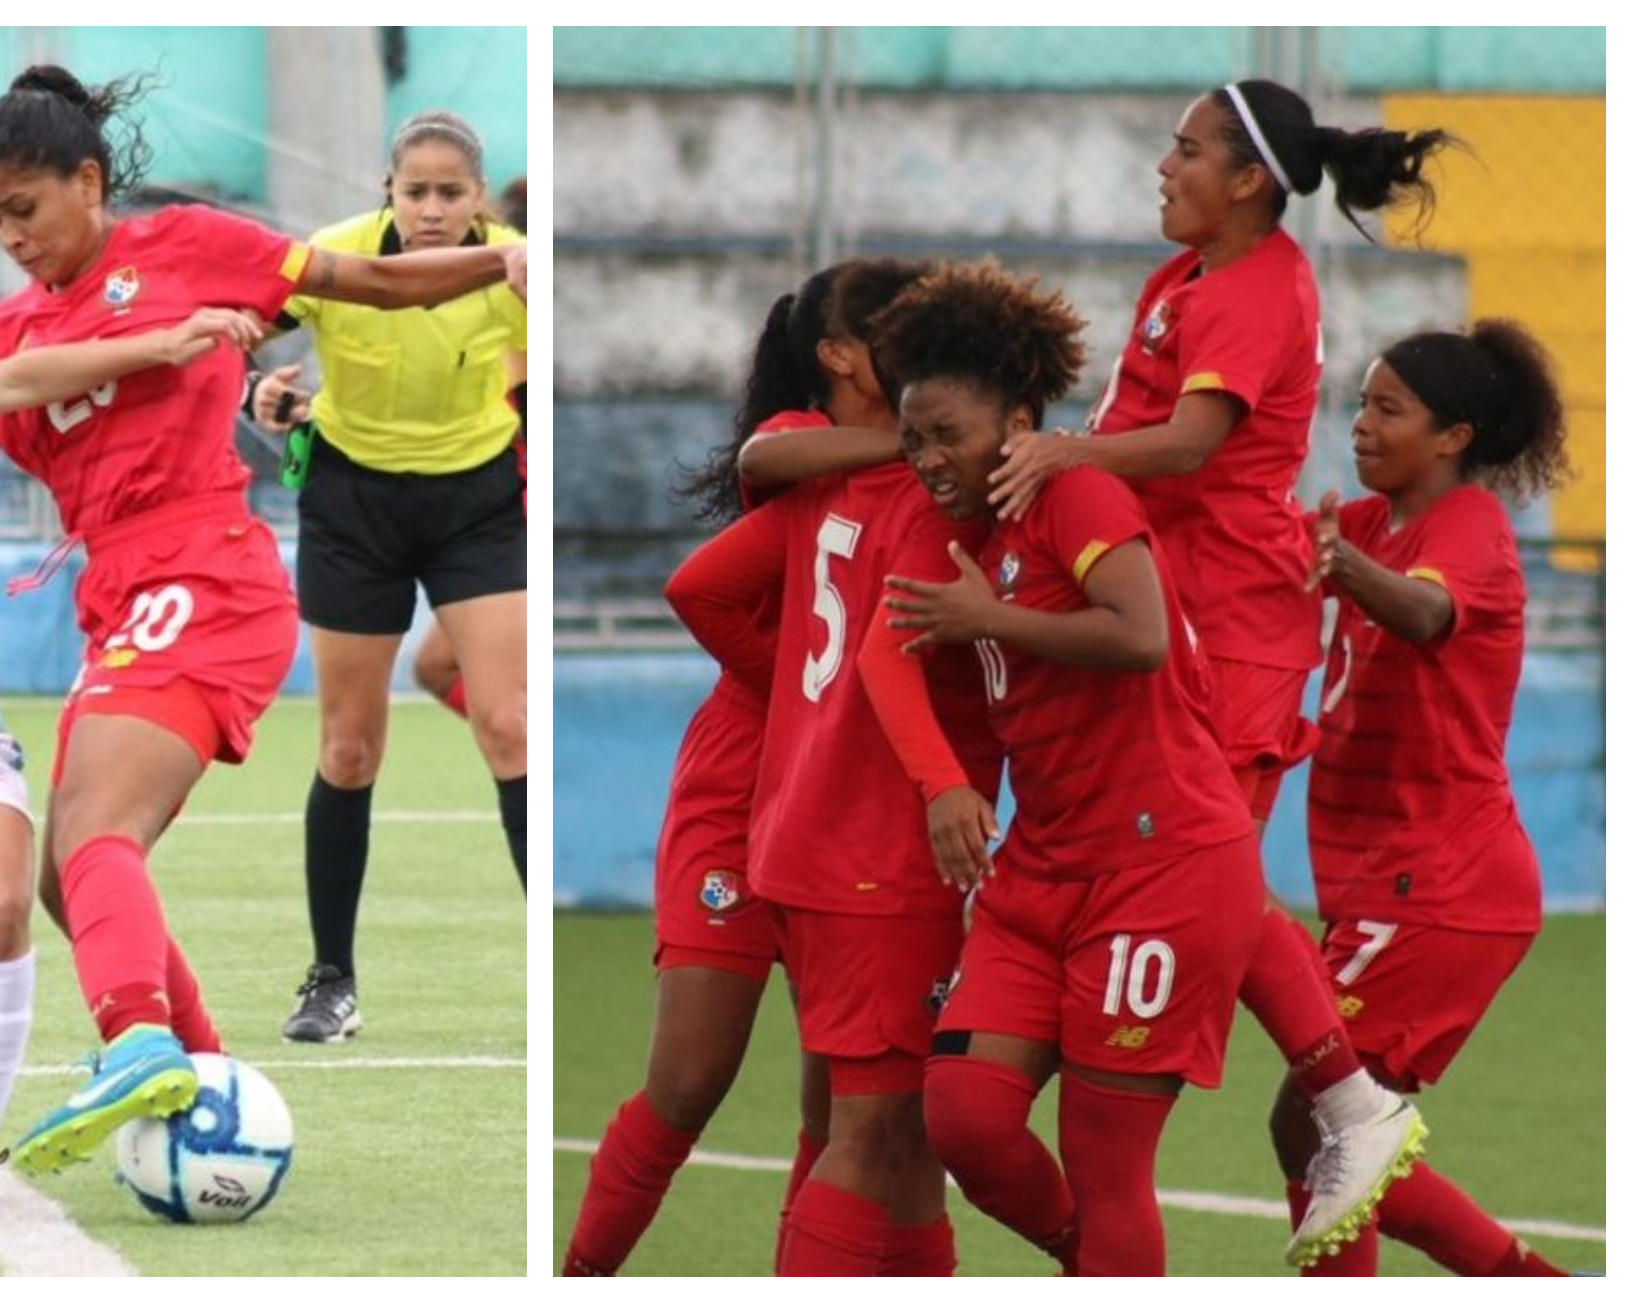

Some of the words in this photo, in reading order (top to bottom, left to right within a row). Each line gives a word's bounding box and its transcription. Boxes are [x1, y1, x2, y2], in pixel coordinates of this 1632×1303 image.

[104, 584, 194, 653] 20
[802, 512, 863, 703] 5
[1102, 932, 1176, 1019] 10
[1335, 919, 1399, 986] 7
